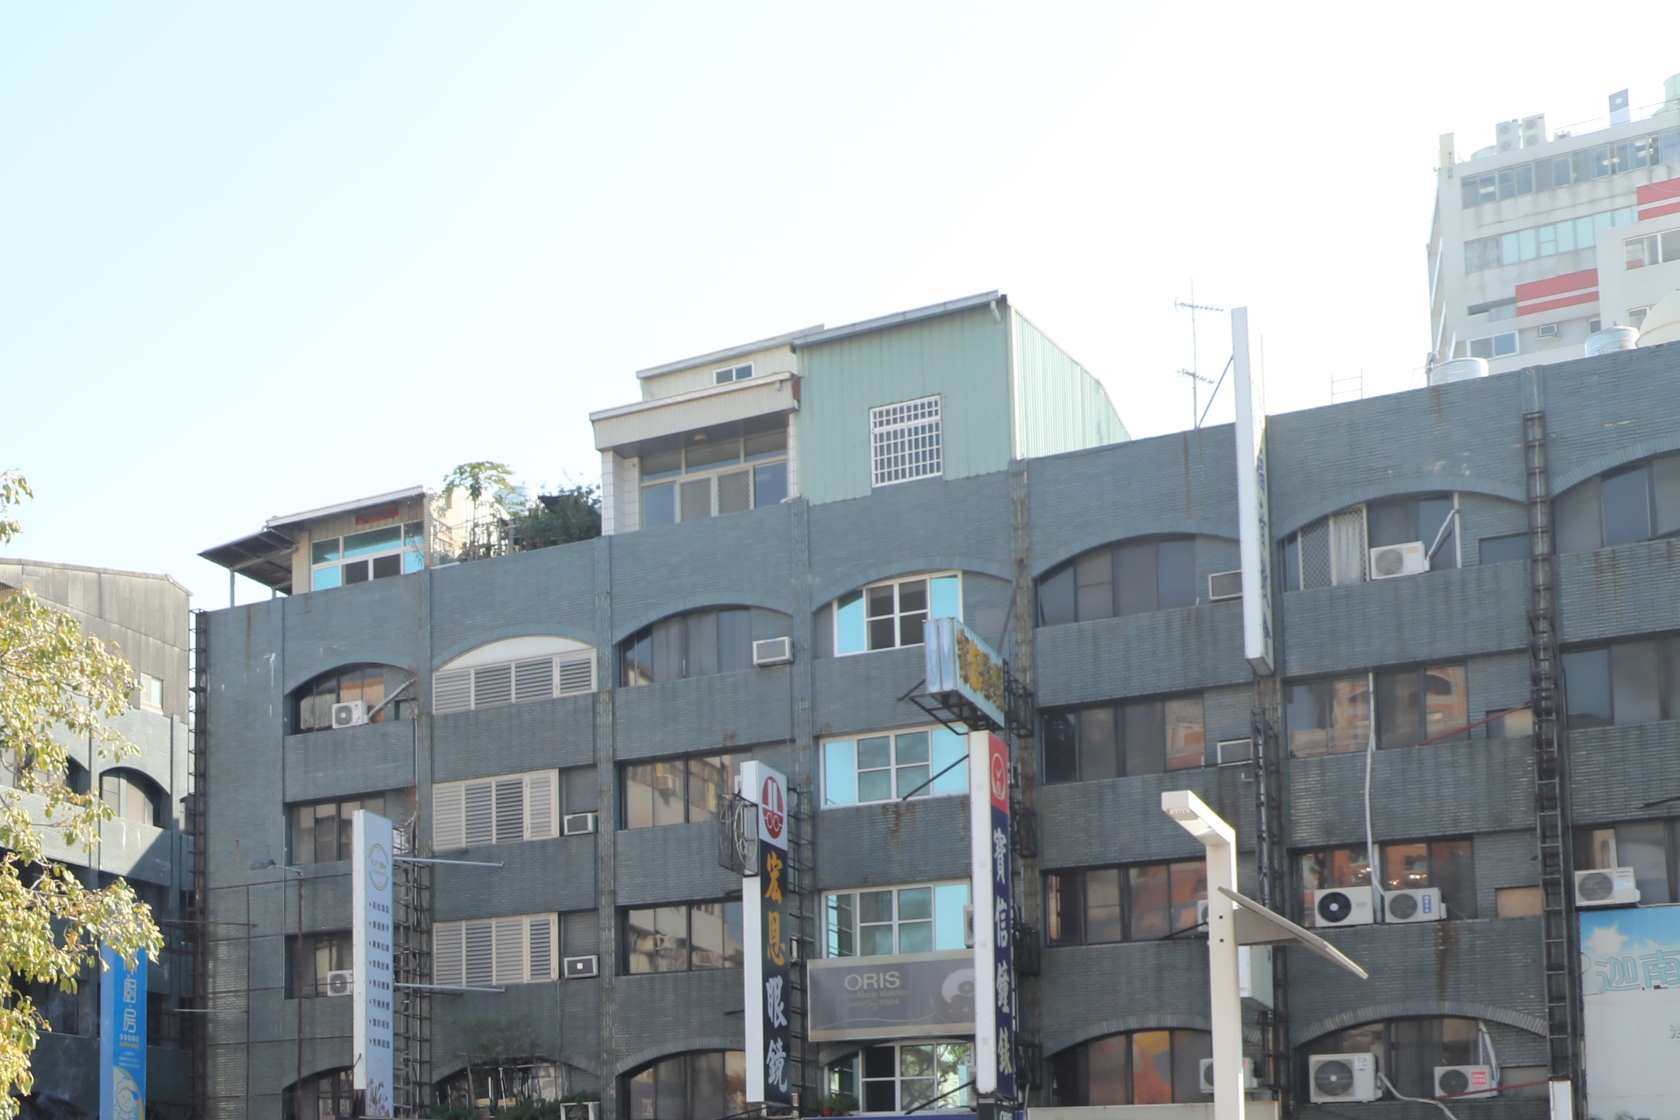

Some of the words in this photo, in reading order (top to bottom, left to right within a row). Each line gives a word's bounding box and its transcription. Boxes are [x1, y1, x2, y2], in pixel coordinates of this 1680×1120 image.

[765, 851, 788, 1093] 宏恩眼鏡
[844, 971, 901, 991] ORIS
